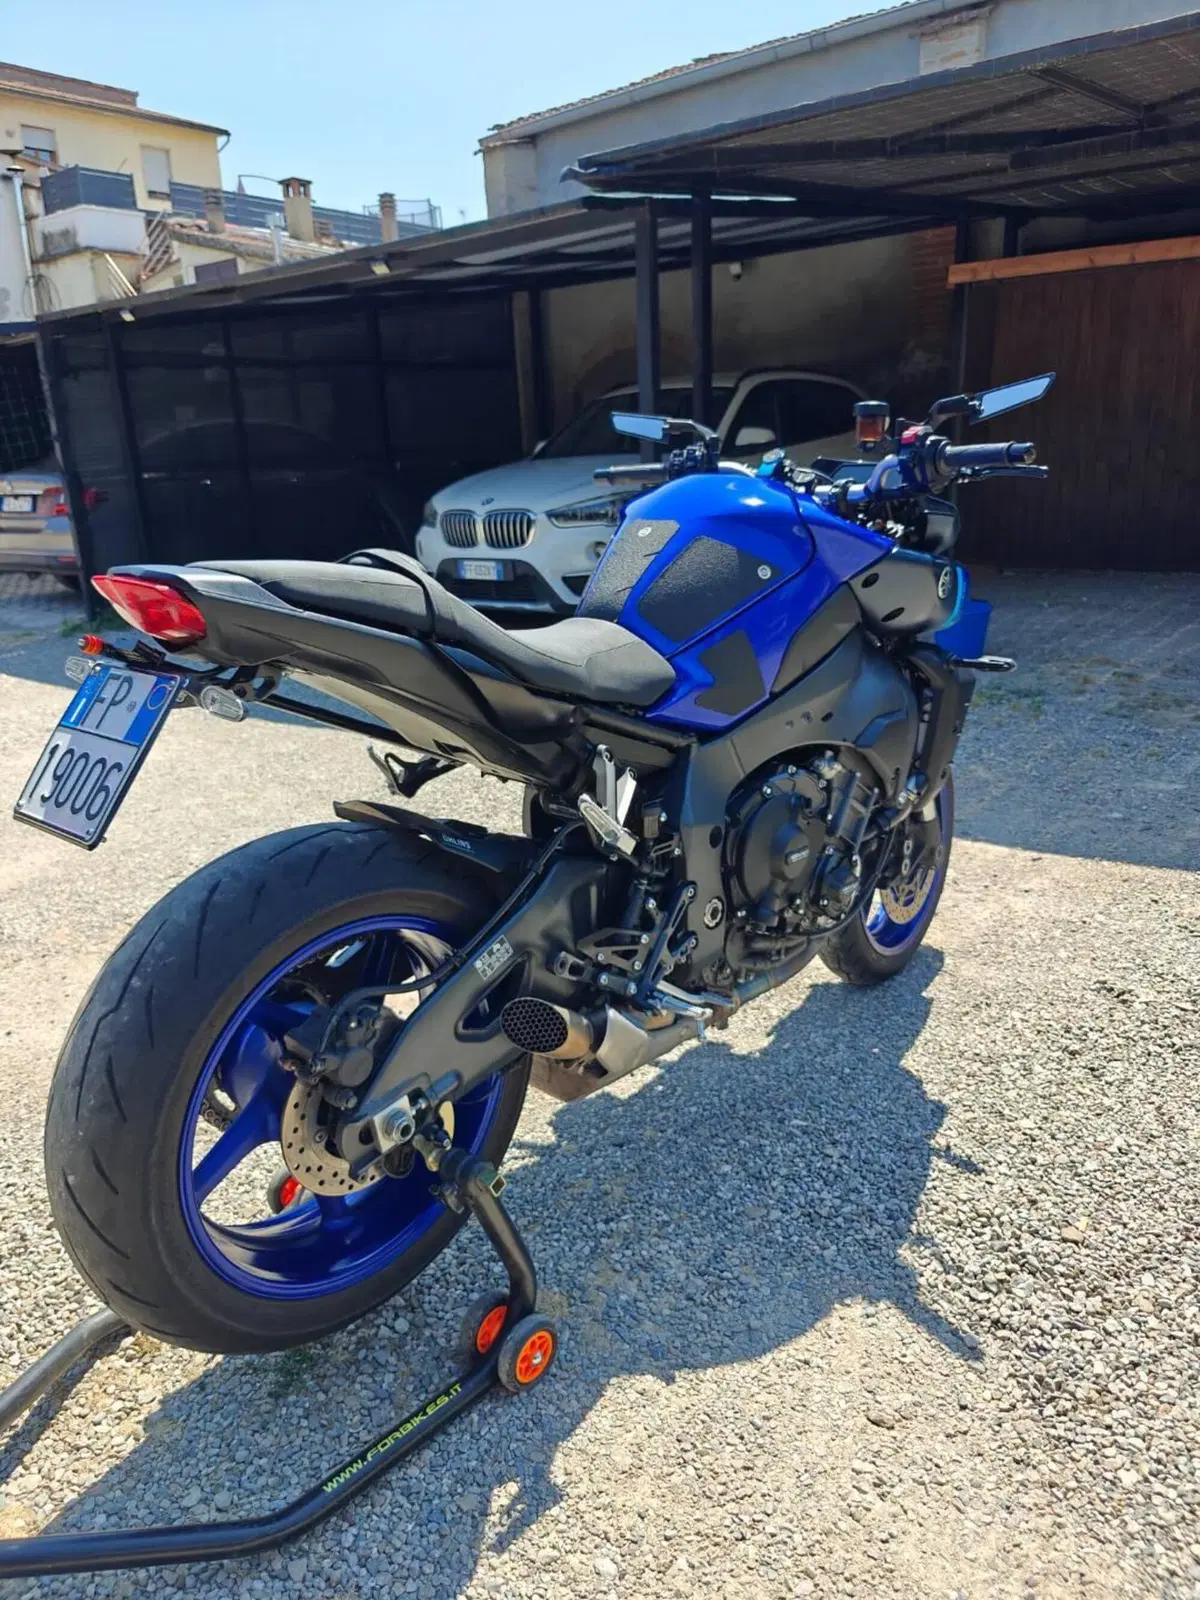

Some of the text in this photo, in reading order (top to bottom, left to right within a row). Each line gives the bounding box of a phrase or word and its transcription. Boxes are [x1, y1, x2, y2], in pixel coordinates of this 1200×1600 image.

[80, 673, 134, 730] FP
[29, 743, 123, 821] 19006
[322, 1383, 462, 1493] WWW.FORBIKES.IT
